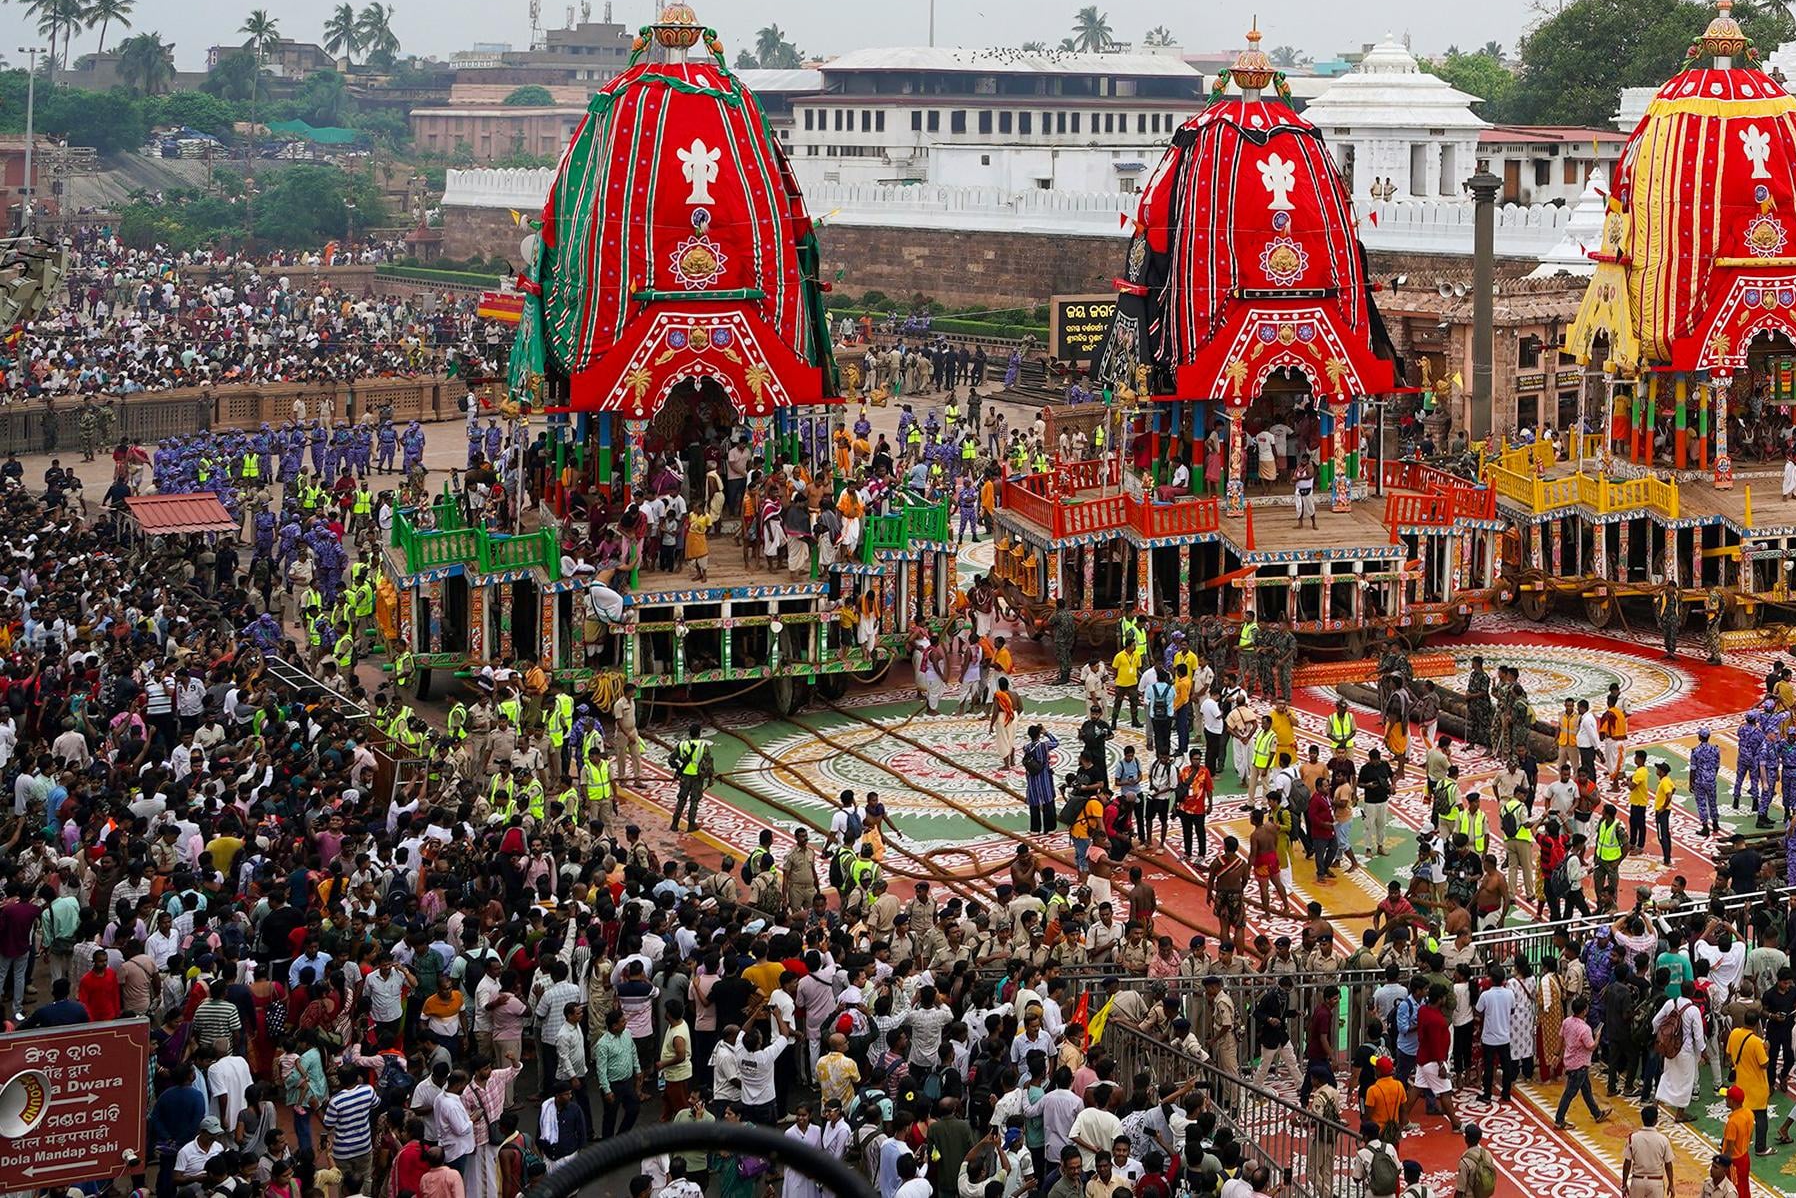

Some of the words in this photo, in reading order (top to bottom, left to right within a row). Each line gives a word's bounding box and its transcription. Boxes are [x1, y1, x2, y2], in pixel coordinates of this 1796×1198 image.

[1066, 305, 1086, 318] ଜୟ
[24, 1046, 60, 1064] ସିଂହ
[66, 1043, 102, 1061] ଦ୍ୱାର
[68, 1063, 92, 1079] द्वार
[68, 1077, 123, 1093] Dwara
[22, 1083, 42, 1122] SOUND
[47, 1111, 87, 1128] ମଣ୍ଡପ
[92, 1103, 121, 1122] ସାହି
[1, 1155, 31, 1167] Dola
[34, 1147, 86, 1163] Mandap
[90, 1140, 118, 1155] Sahi
